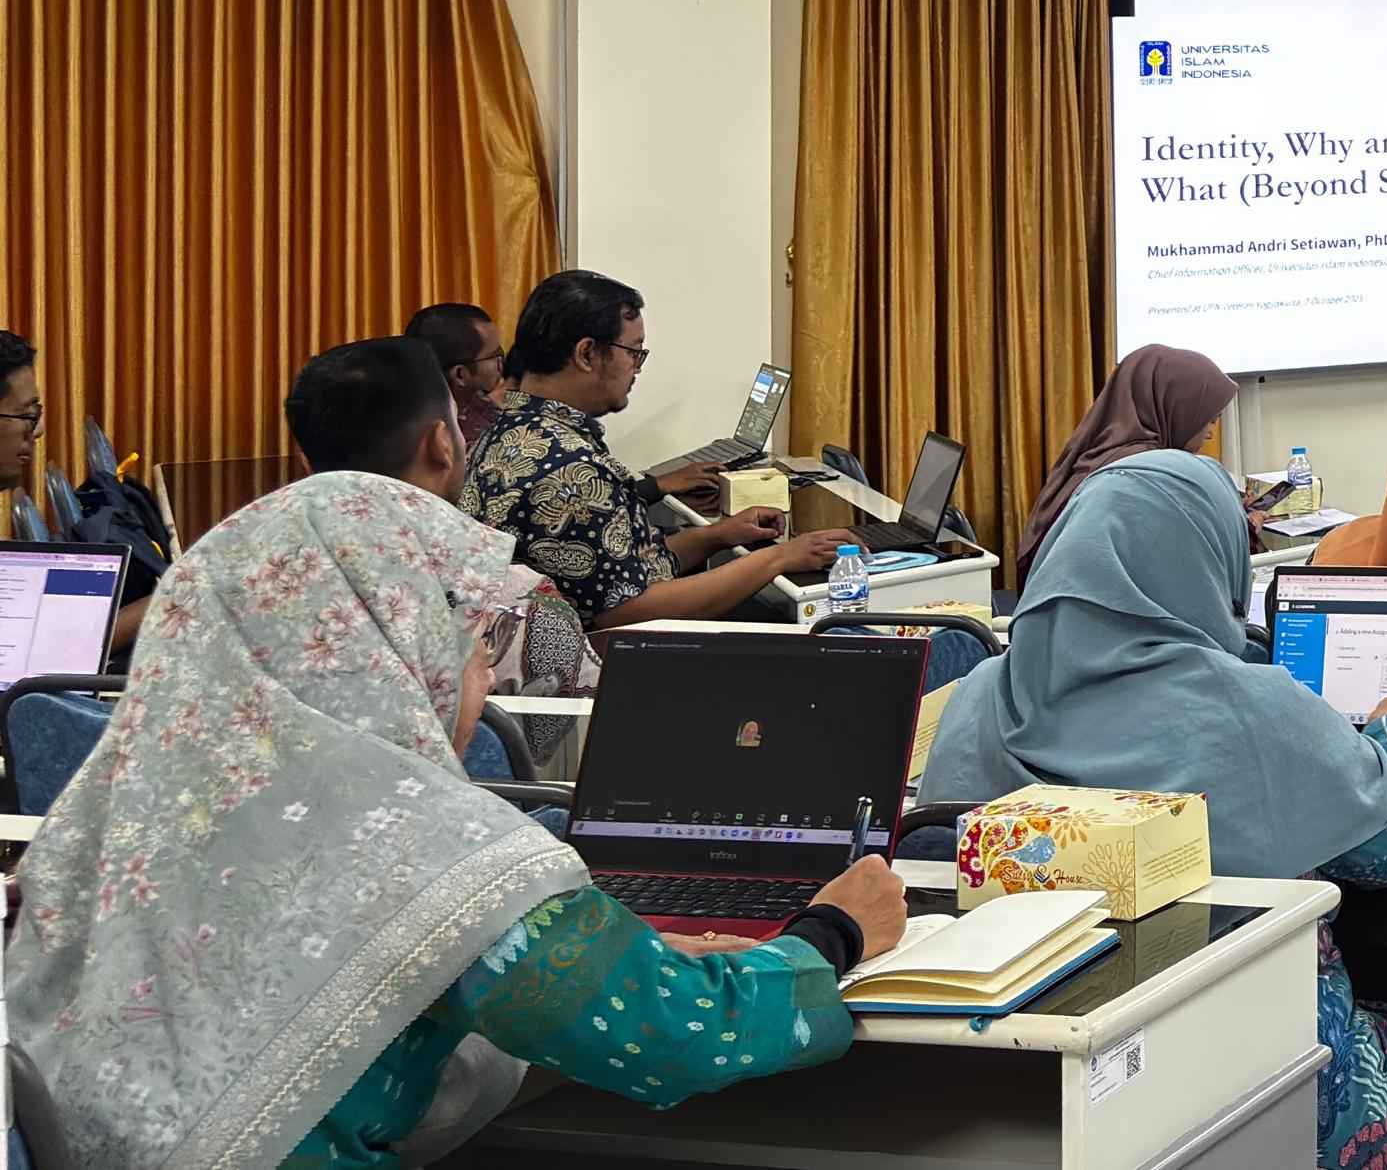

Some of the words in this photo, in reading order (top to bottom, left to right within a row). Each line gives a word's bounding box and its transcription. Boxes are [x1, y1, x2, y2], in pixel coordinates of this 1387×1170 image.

[1181, 44, 1270, 55] UNIVERSITAS
[1181, 57, 1225, 66] ISLAM
[1181, 69, 1252, 79] INDONESIA
[1141, 134, 1275, 166] Identity,
[1284, 131, 1354, 163] Why
[1141, 176, 1228, 204] What
[1239, 170, 1368, 207] (Beyond
[1147, 241, 1244, 258] Mukhammad
[1247, 238, 1287, 254] Andri
[1290, 236, 1362, 251] Setiawan,
